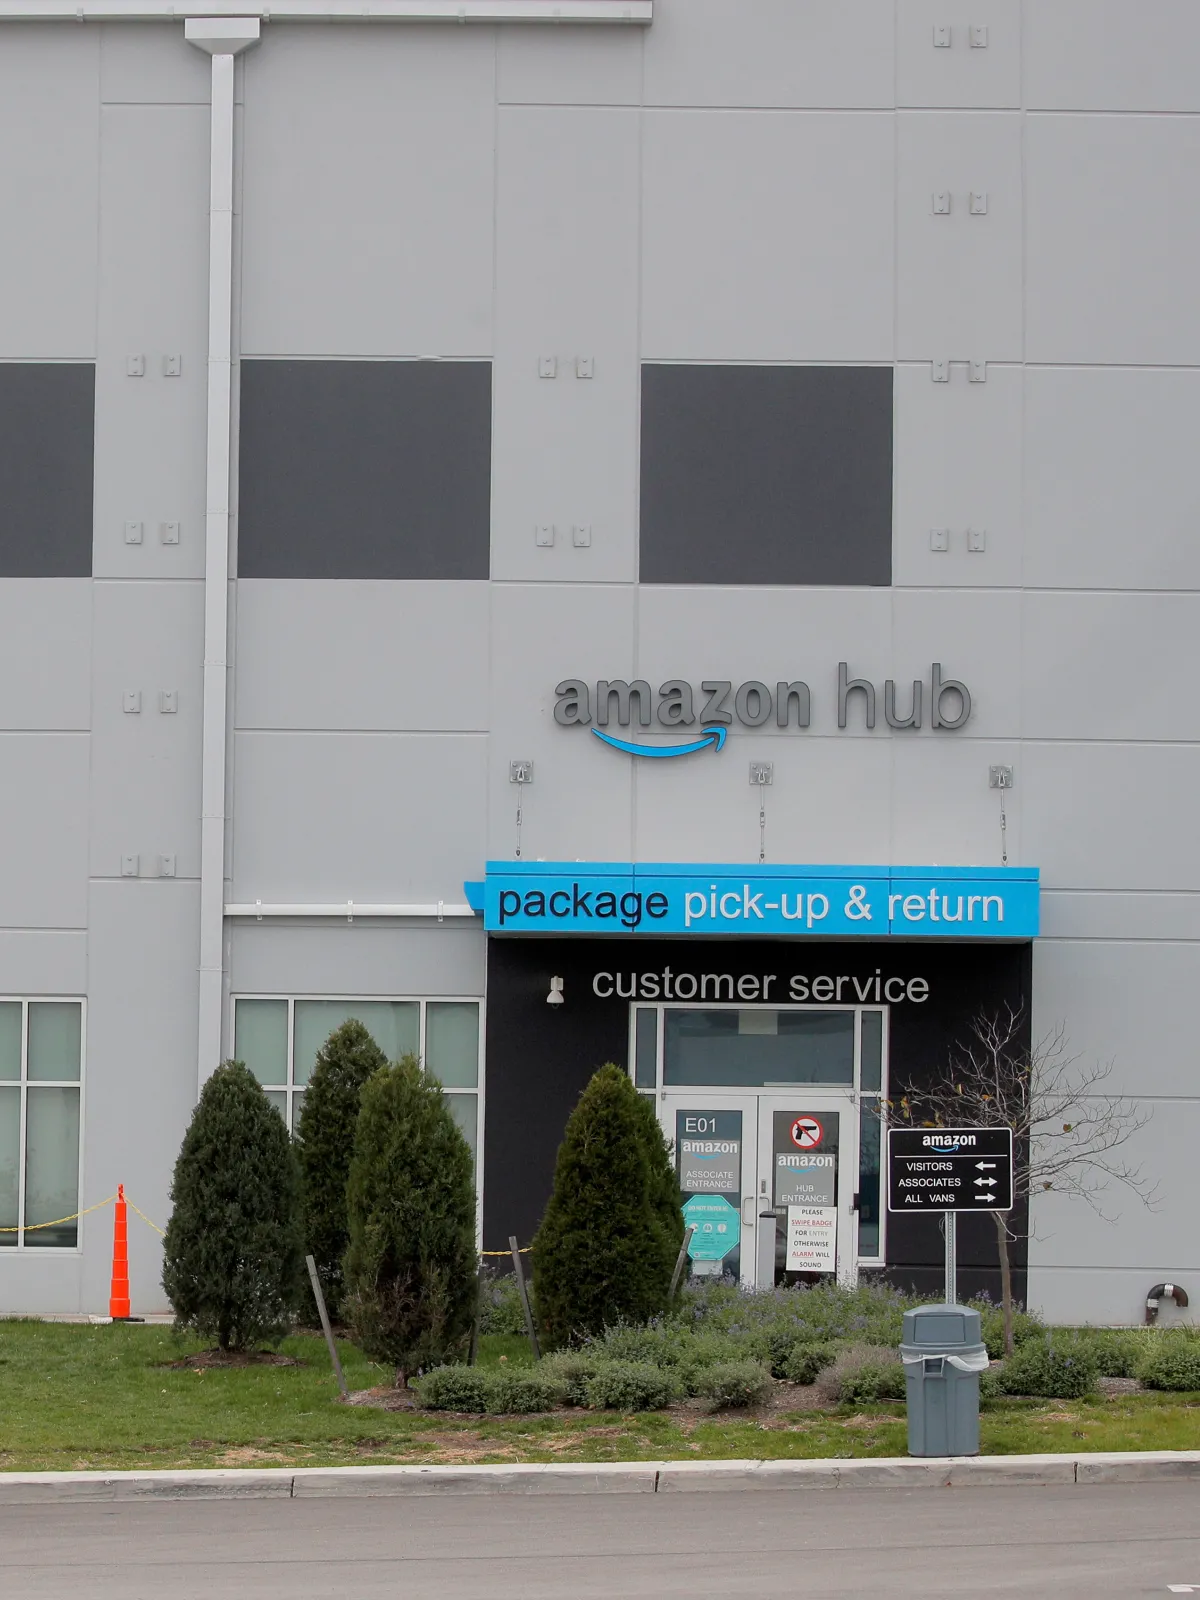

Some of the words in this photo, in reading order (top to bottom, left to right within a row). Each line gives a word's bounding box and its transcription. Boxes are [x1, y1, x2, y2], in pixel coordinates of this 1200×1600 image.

[553, 678, 811, 728] amazon
[837, 661, 972, 729] hub
[499, 883, 669, 928] package
[685, 884, 830, 928] pick-up
[844, 885, 872, 920] &
[888, 888, 1004, 922] return
[592, 966, 777, 1000] customer
[789, 968, 930, 1003] service
[685, 1117, 717, 1133] E01
[922, 1135, 977, 1146] amazon
[682, 1141, 738, 1153] amazon
[778, 1155, 833, 1167] amazon
[906, 1162, 953, 1171] VISITORS
[686, 1170, 734, 1179] ASSOCIATE
[686, 1180, 733, 1189] ENTRANCE
[898, 1178, 962, 1187] ASSOCIATES
[796, 1184, 814, 1192] HUB
[781, 1194, 828, 1203] ENTRANCE
[904, 1194, 923, 1203] ALL
[929, 1194, 955, 1203] VANS
[811, 1219, 833, 1227] BADGE
[793, 1240, 829, 1248] OTHERWISE
